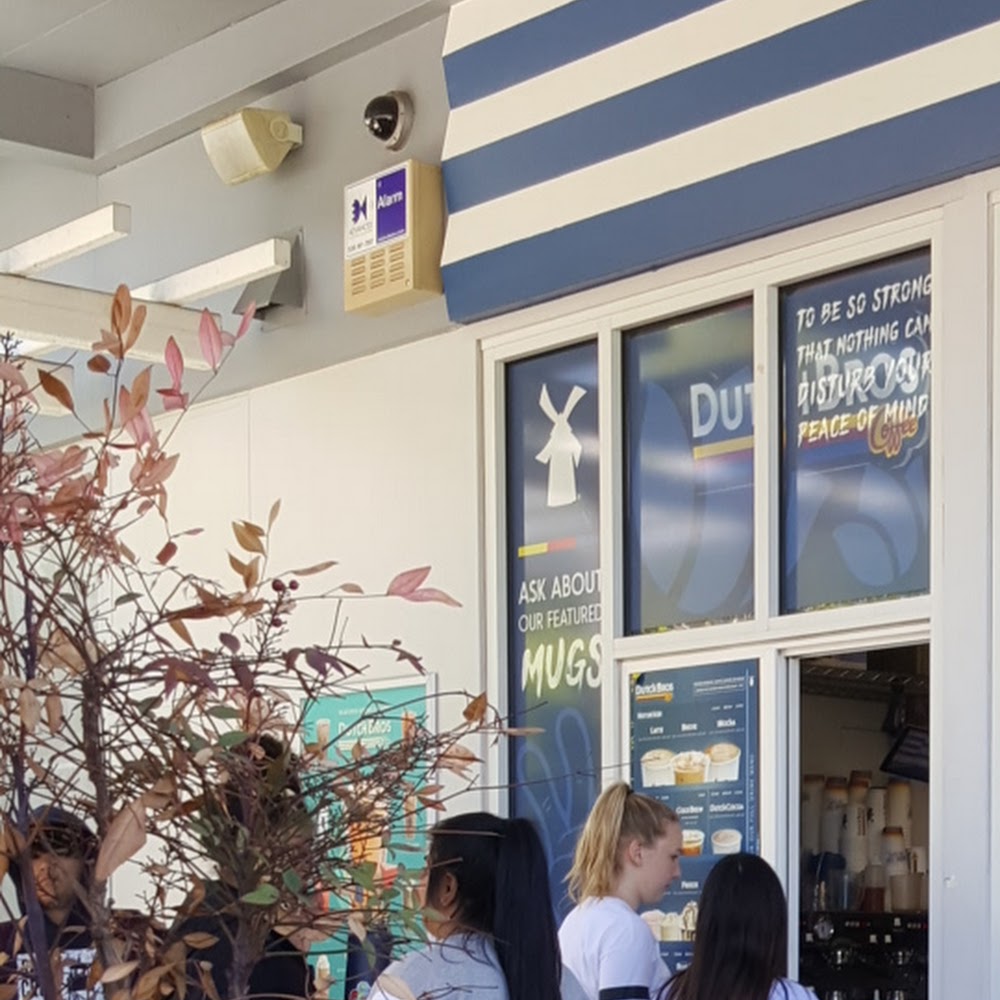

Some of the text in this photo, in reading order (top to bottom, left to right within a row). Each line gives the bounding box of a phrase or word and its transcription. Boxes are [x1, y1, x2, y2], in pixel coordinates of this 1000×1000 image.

[377, 191, 404, 209] Alarm
[797, 272, 931, 333] TO BE SO STRONG
[797, 338, 835, 369] THAT
[836, 320, 899, 357] NOTHING
[797, 364, 876, 408] DISTURB
[797, 394, 929, 449] PEACE OF MIND
[518, 567, 602, 606] ASK ABOUT
[518, 602, 603, 633] OUR FEATURED
[521, 633, 604, 699] MUGS
